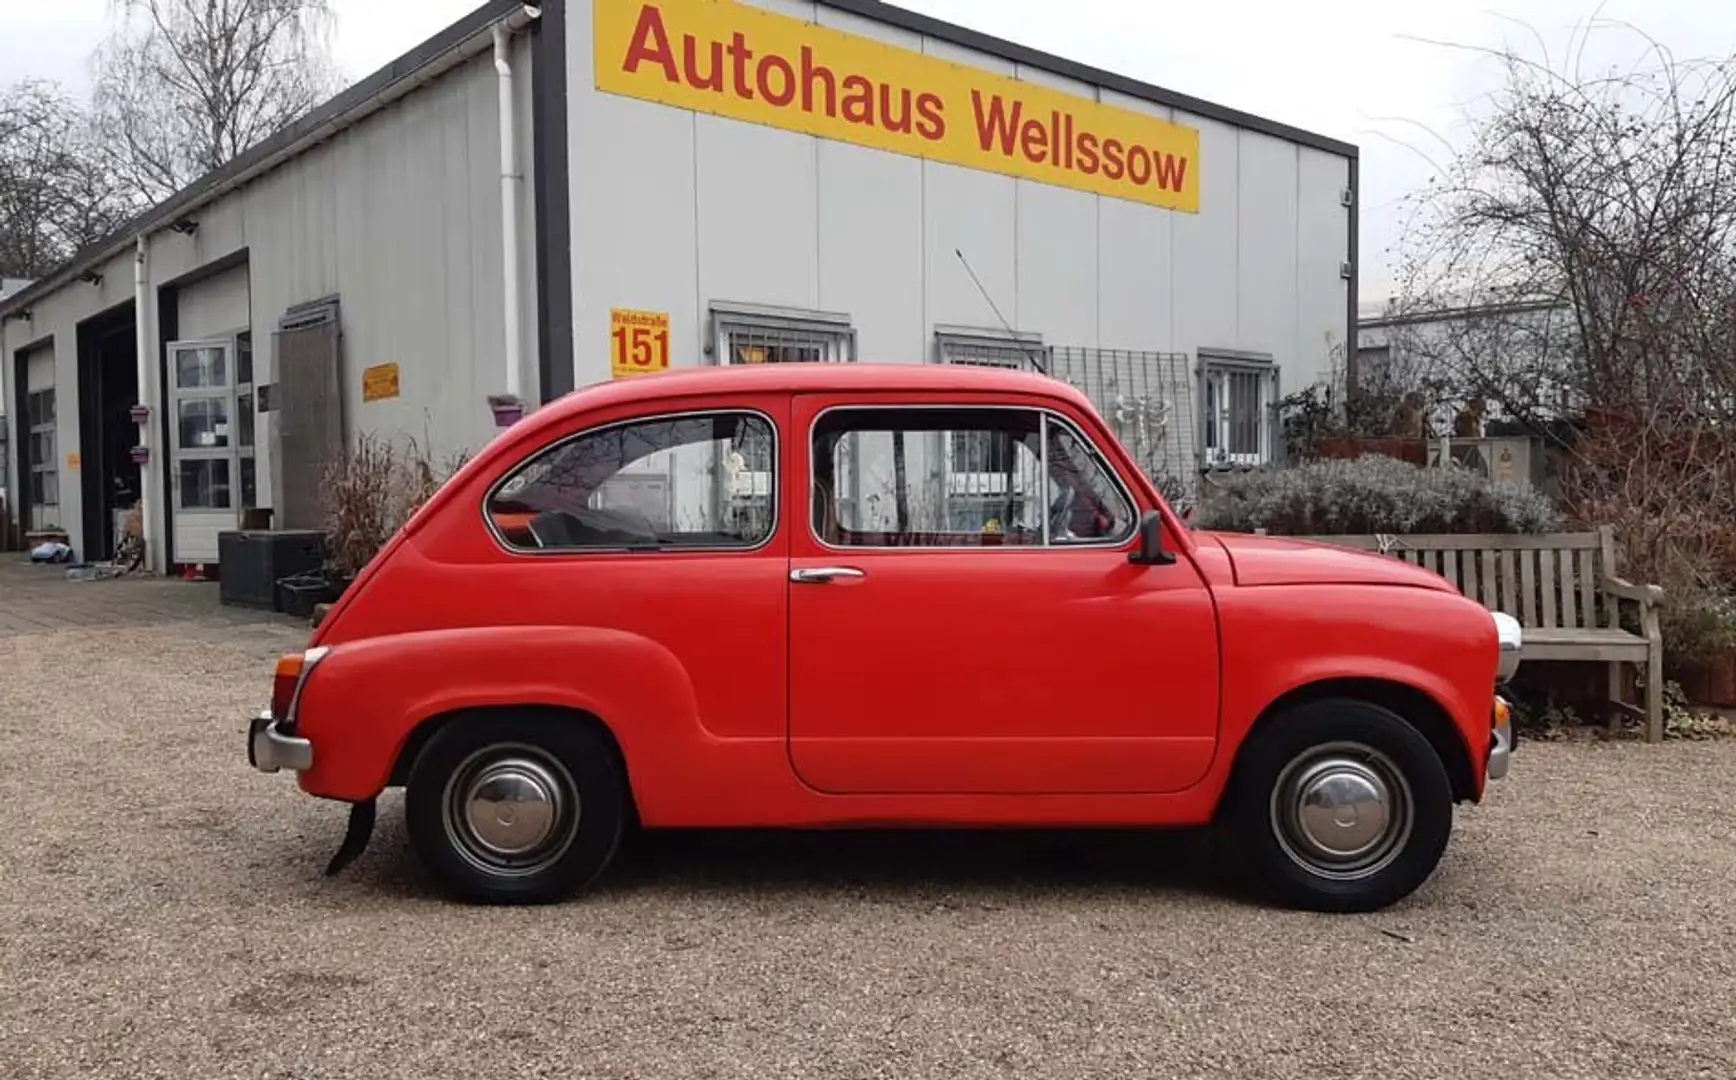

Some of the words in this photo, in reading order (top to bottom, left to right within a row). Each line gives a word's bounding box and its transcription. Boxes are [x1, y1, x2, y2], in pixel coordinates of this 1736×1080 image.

[622, 4, 946, 141] Autohaus
[970, 88, 1188, 193] Wellssow
[612, 326, 668, 368] 151
